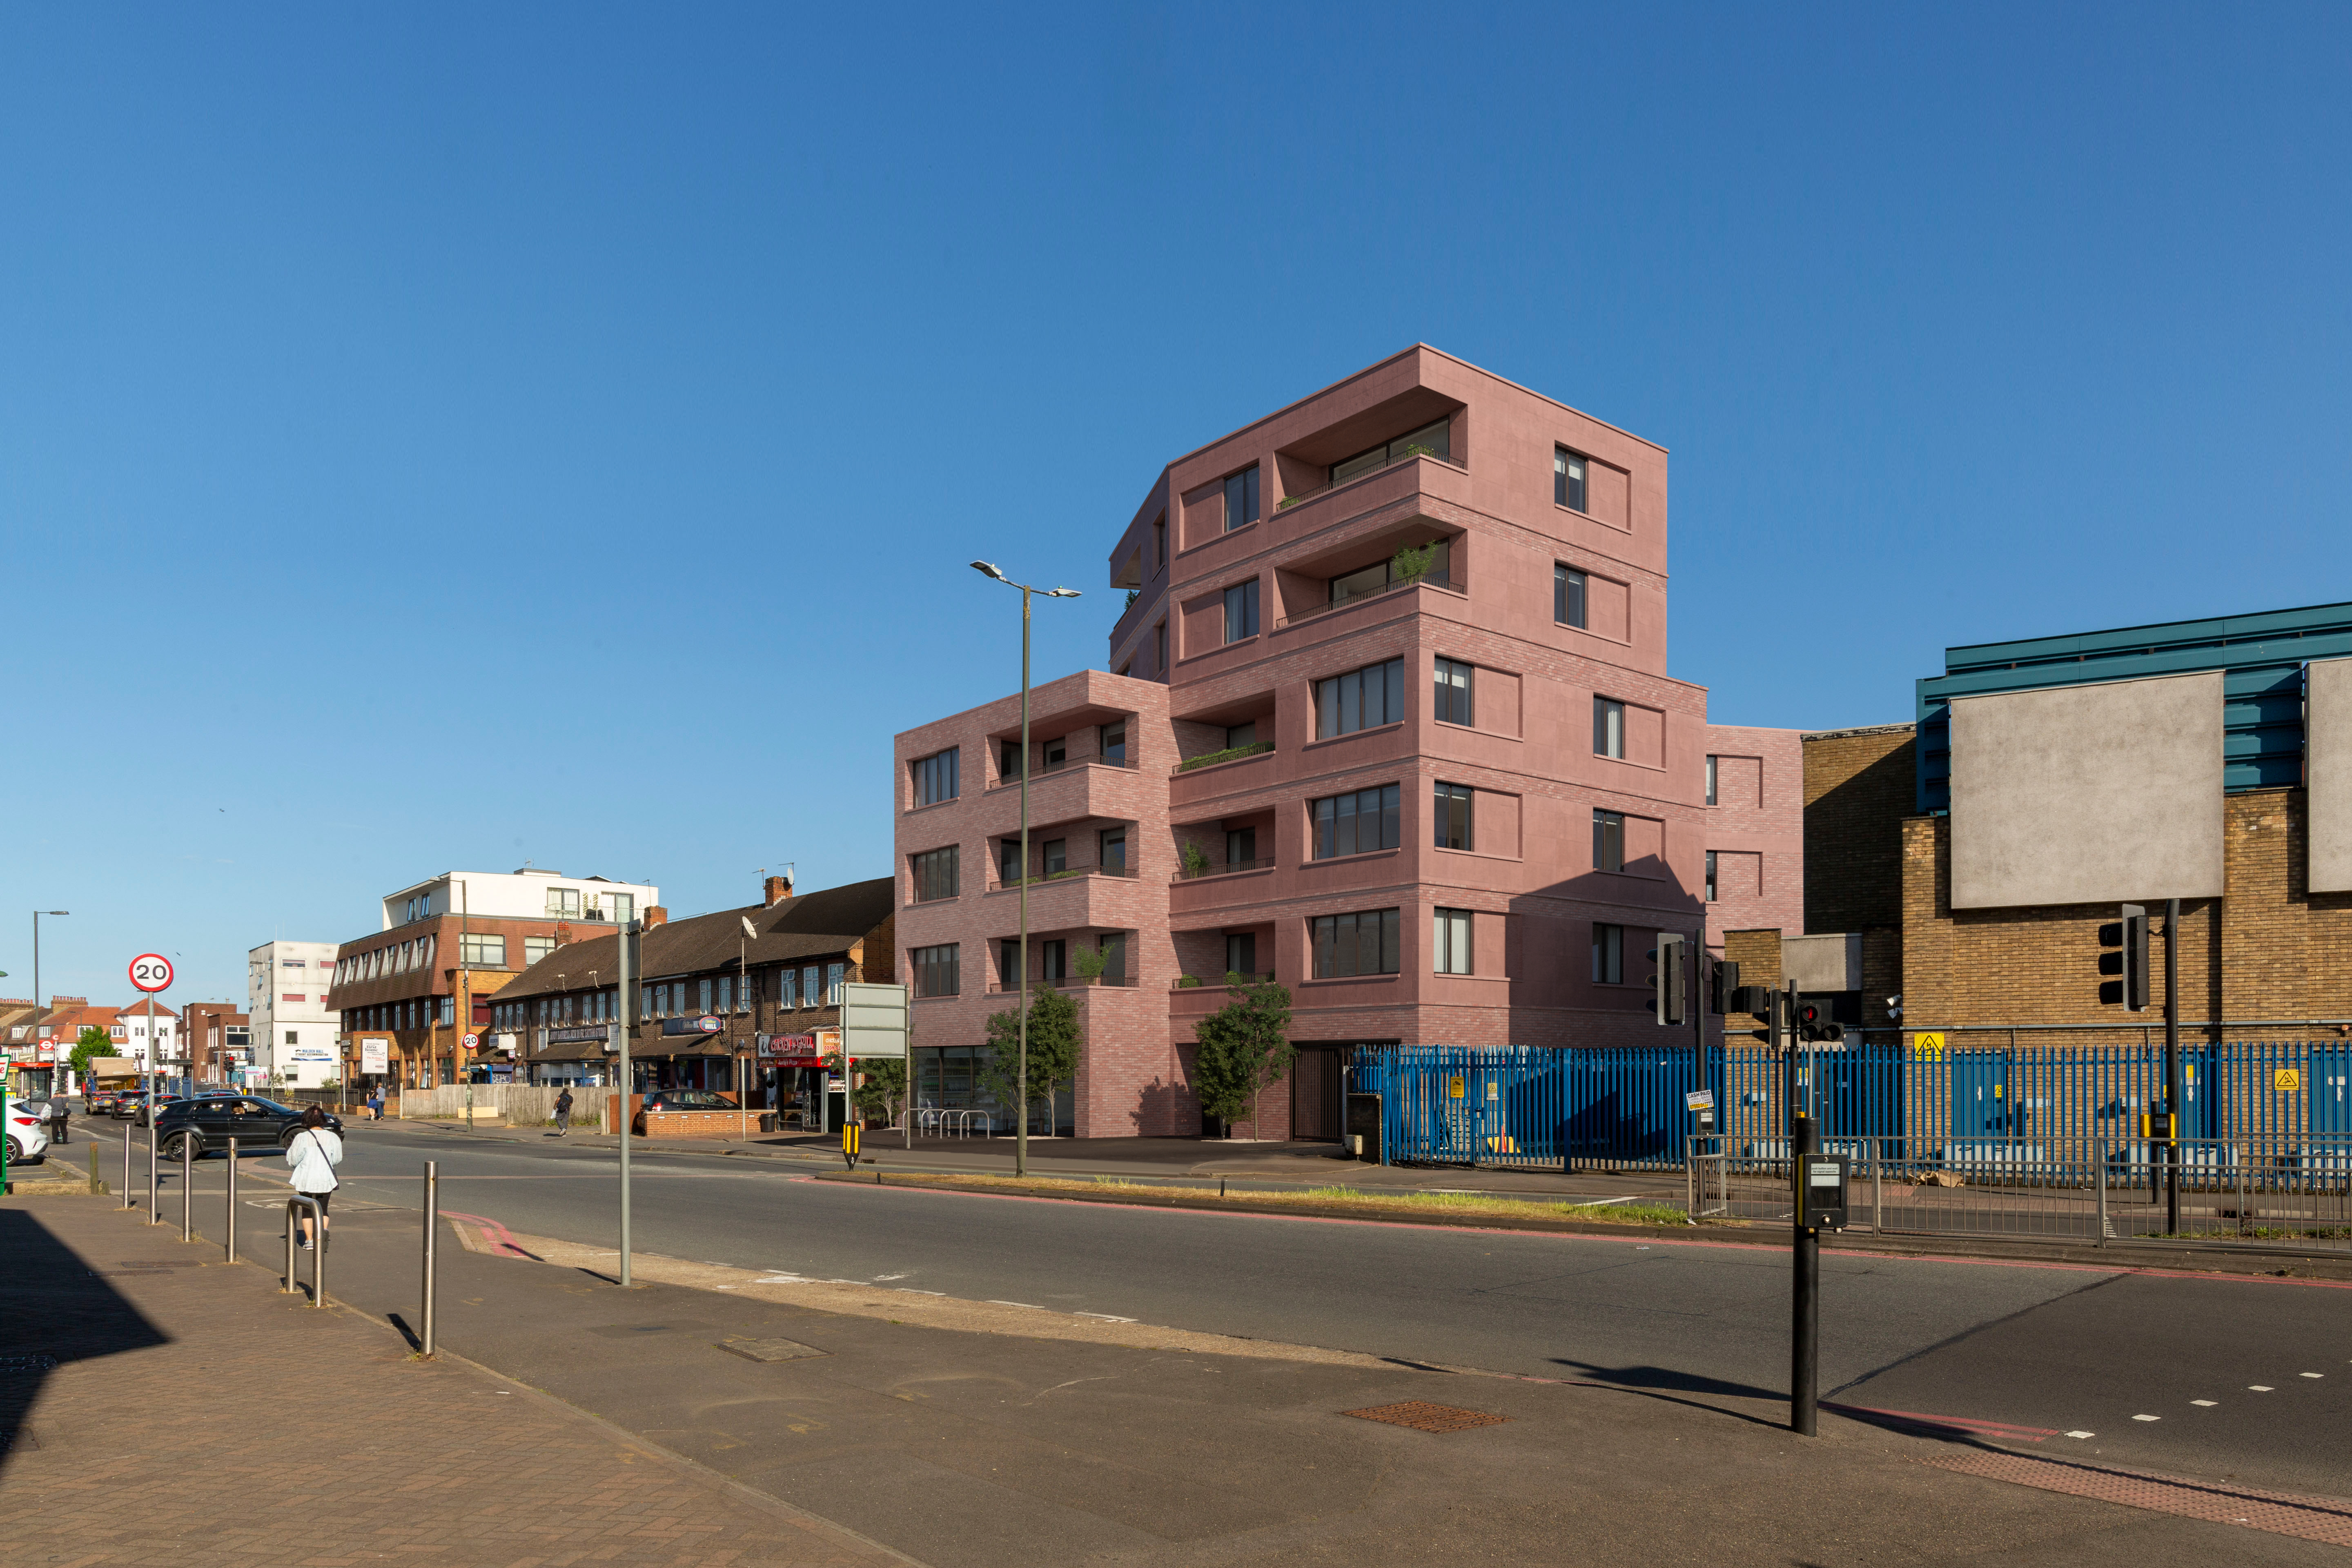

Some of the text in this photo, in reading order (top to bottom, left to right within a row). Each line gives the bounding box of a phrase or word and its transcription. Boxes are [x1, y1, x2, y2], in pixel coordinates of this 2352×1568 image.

[136, 964, 167, 980] 20
[585, 1028, 595, 1038] TATTOO
[595, 1027, 606, 1037] STUDIO
[771, 1037, 792, 1052] CHICKEN
[797, 1036, 815, 1054] GRILL
